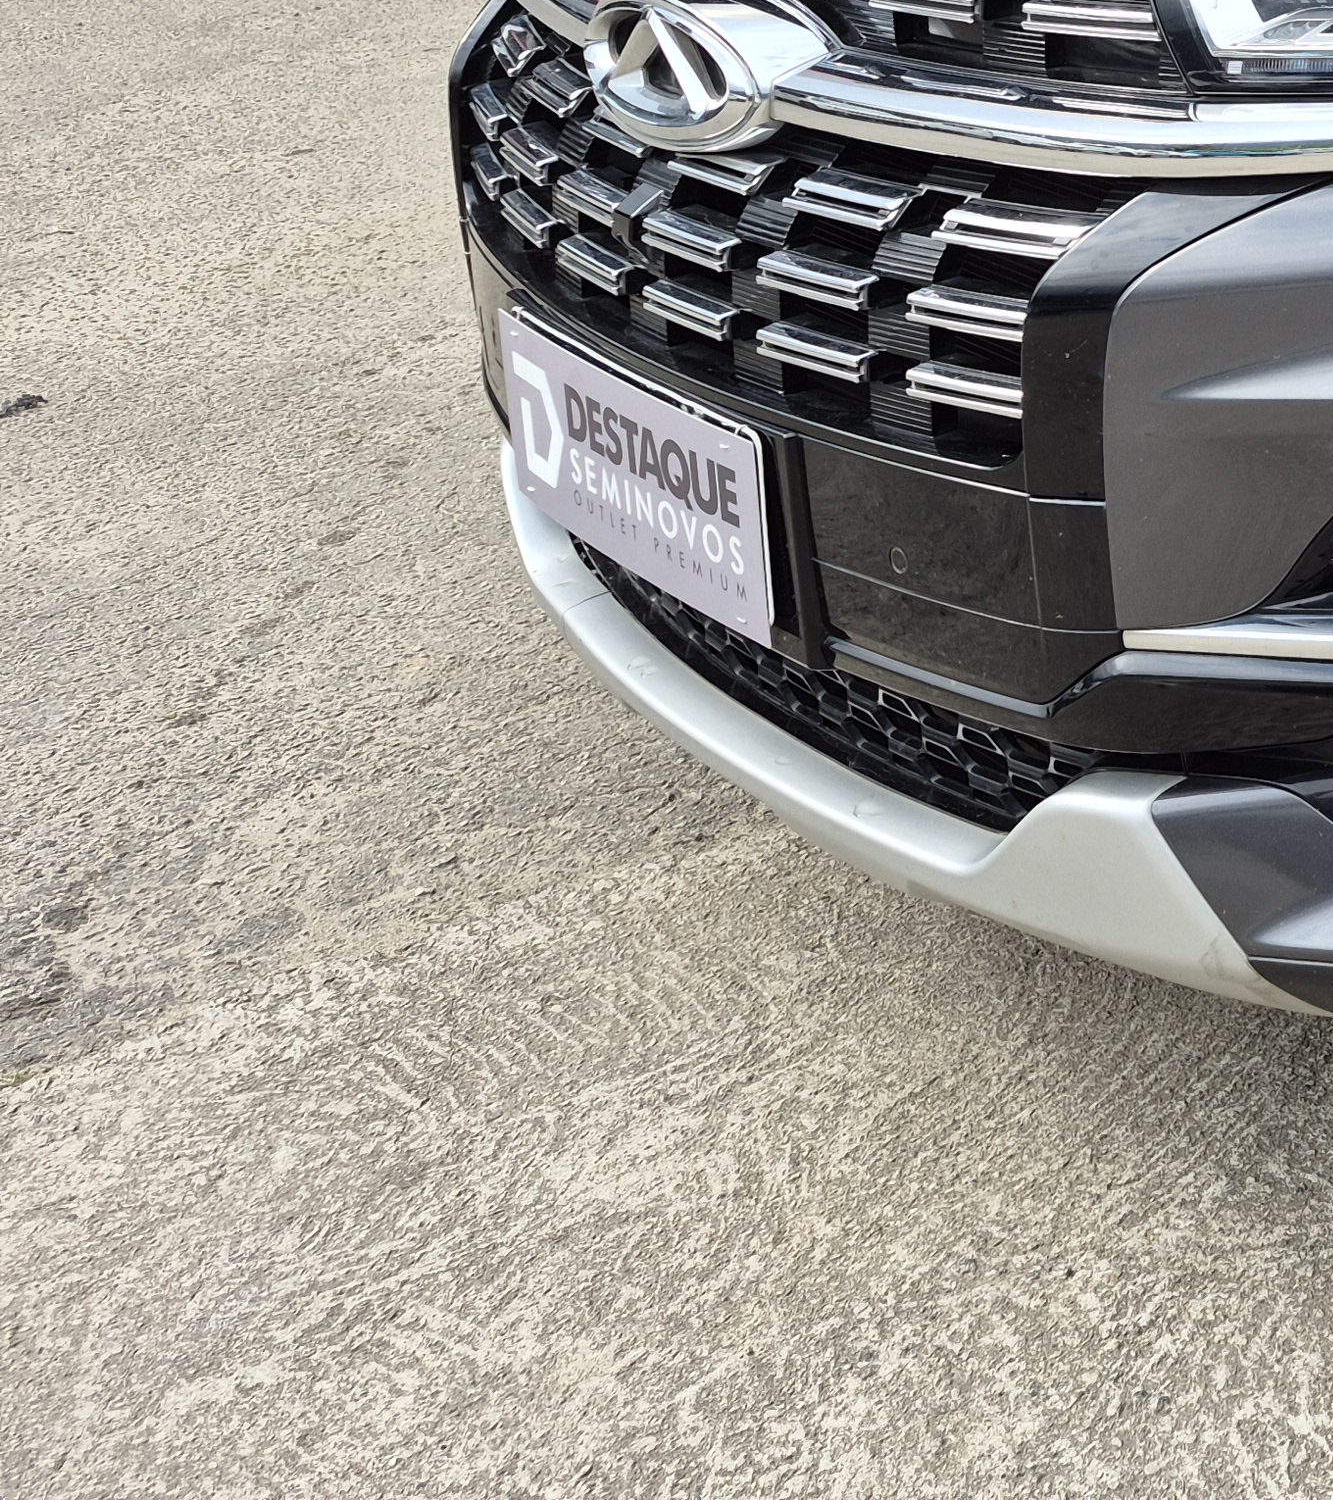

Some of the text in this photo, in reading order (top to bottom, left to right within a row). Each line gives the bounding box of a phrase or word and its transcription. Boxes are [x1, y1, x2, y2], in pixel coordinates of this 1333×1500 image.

[564, 383, 741, 529] DESTAQUE
[570, 447, 745, 575] SEMINOVOS
[573, 489, 748, 602] OUTLET PREMIUM
